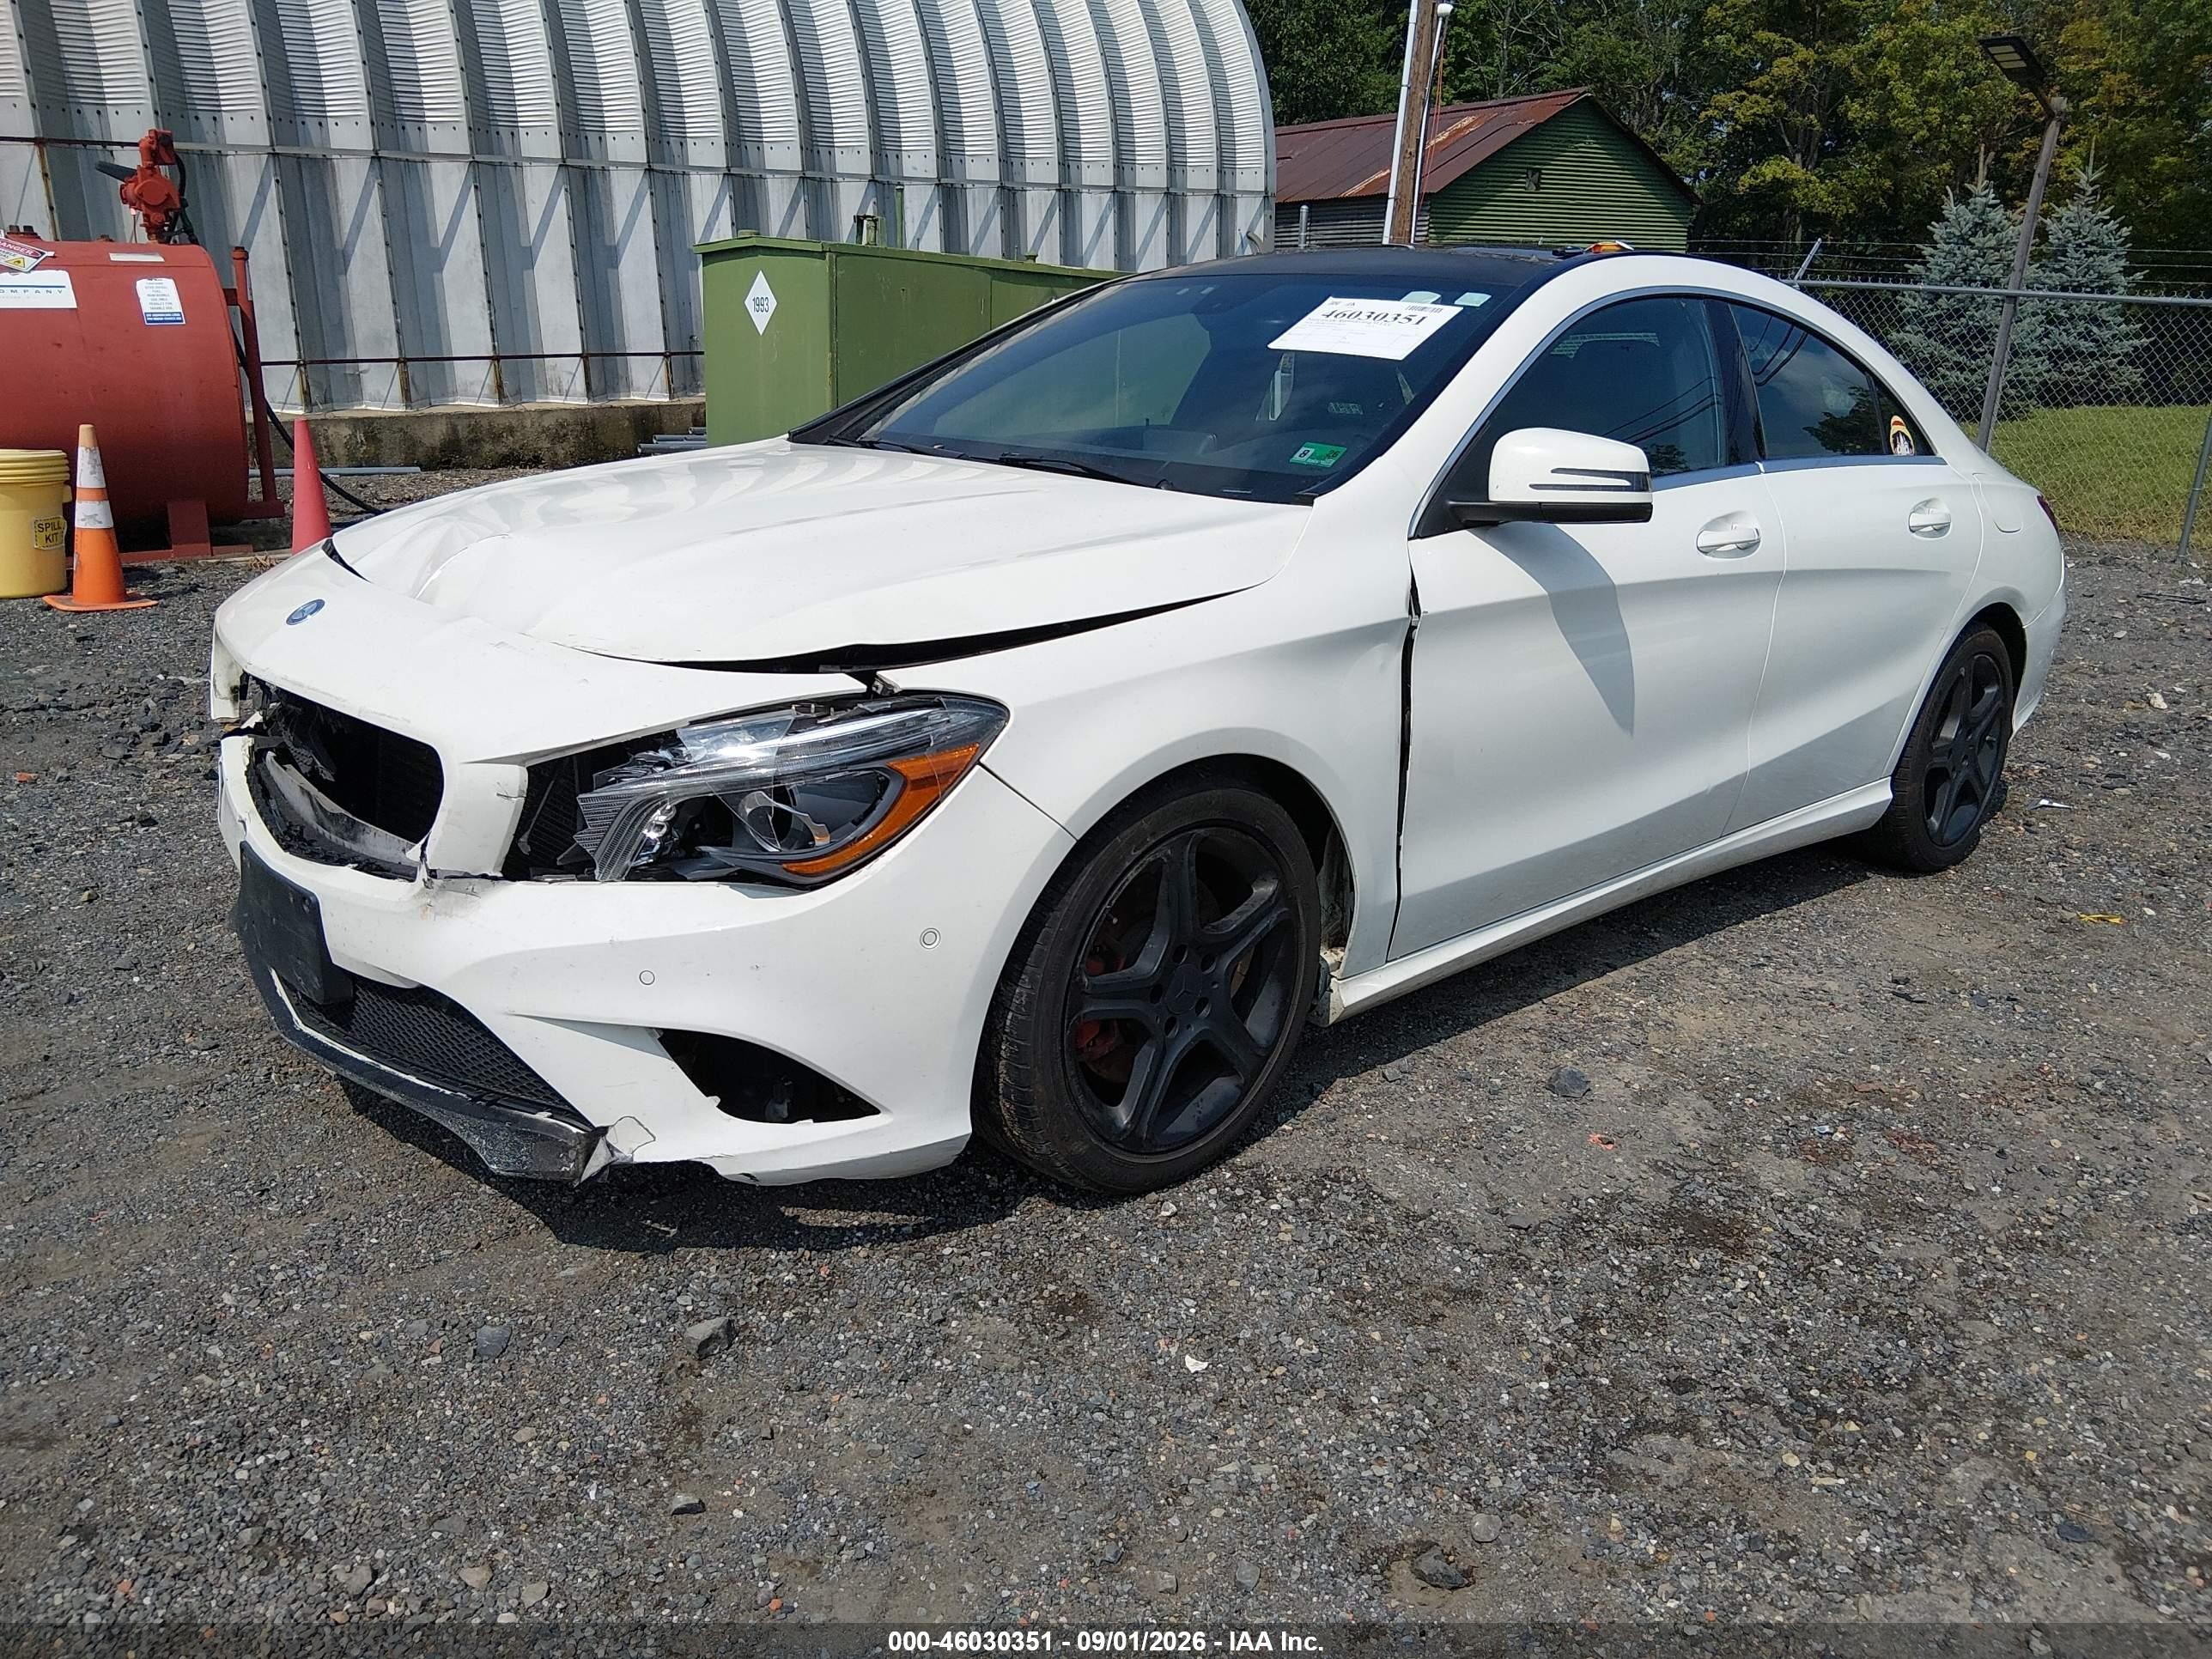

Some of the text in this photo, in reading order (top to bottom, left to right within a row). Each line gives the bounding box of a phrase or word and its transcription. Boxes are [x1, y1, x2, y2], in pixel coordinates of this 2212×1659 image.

[0, 240, 33, 256] ANGER
[752, 296, 769, 313] 1993
[1322, 310, 1428, 325] 46030351
[1298, 449, 1310, 459] 8
[37, 520, 62, 533] SPILL
[45, 532, 59, 544] KIT
